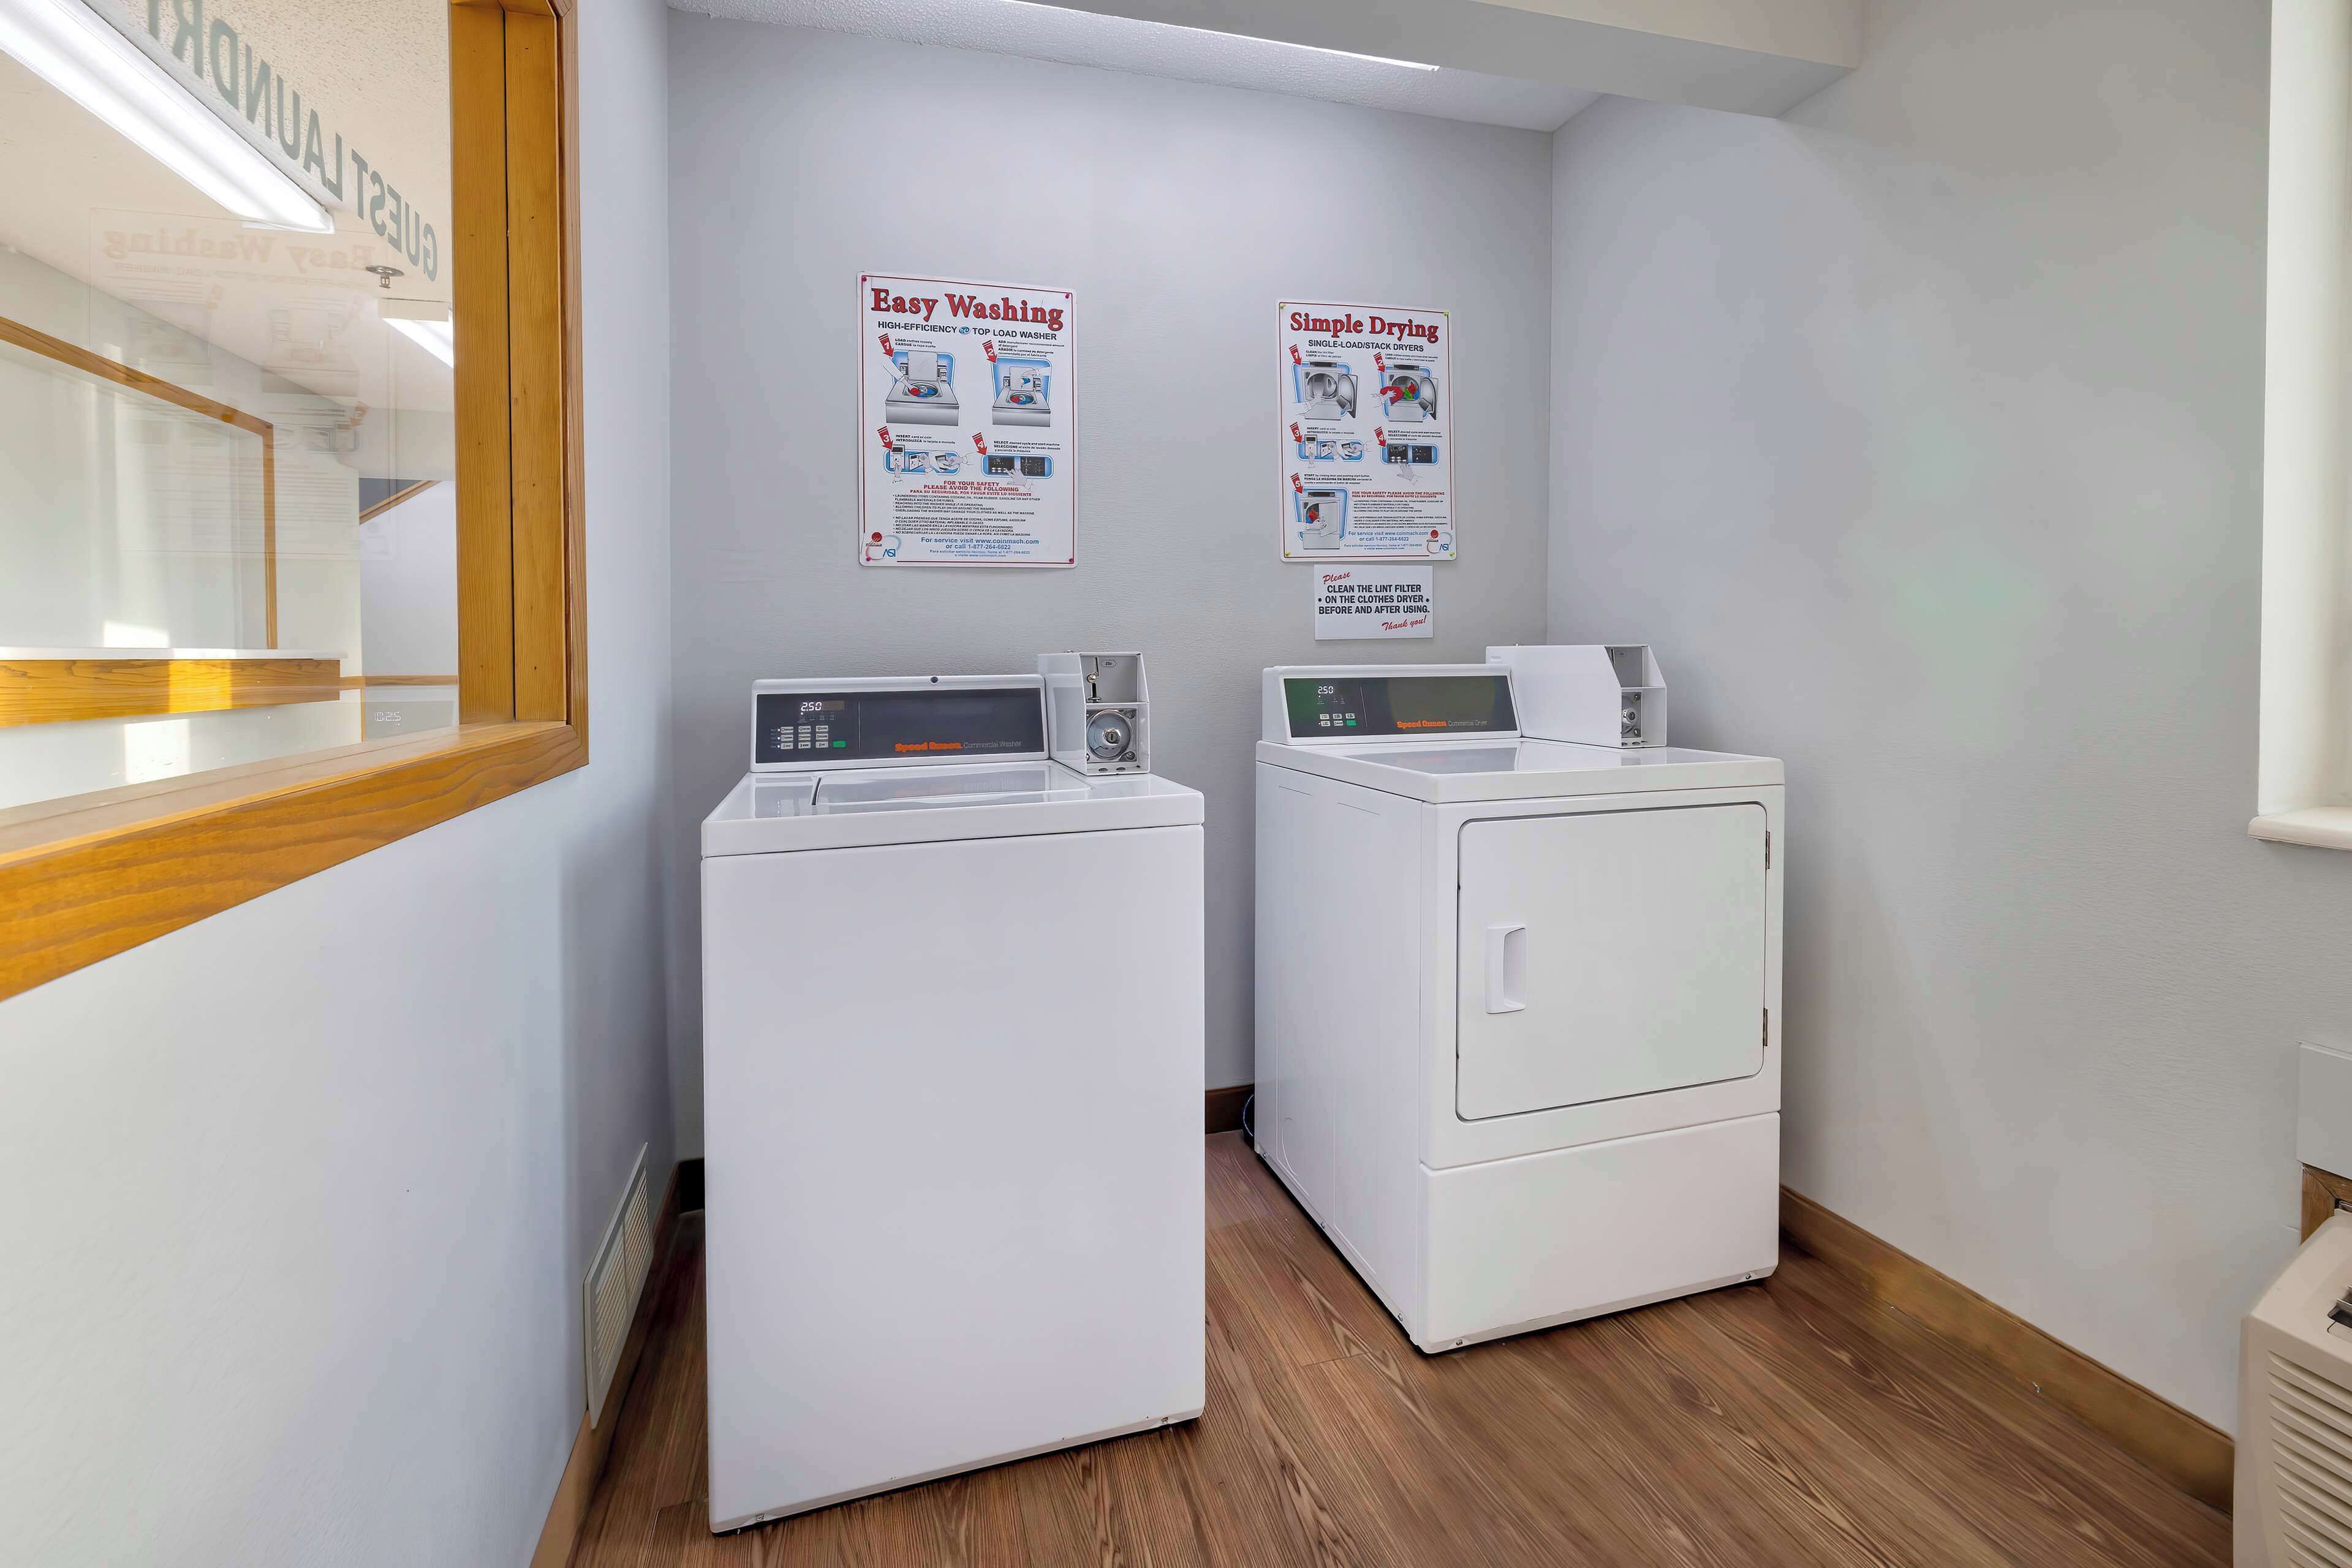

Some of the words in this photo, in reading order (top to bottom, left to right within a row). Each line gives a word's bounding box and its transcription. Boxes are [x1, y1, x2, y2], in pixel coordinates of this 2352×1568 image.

[871, 288, 938, 322] Easy
[945, 293, 1064, 331] Washing
[878, 321, 957, 334] HIGH-EFFICIENCY
[993, 329, 1016, 337] LOAD
[1019, 331, 1057, 340] WASHER
[1290, 312, 1363, 337] Simple
[1369, 316, 1439, 343] Drying
[1309, 339, 1391, 350] SINGLE-LOAD/STACK
[1393, 343, 1424, 352] DRYERS
[1323, 572, 1350, 584] Please
[1382, 620, 1408, 631] Thank
[1410, 615, 1427, 628] you!
[801, 702, 822, 711] 2.50
[1397, 720, 1421, 729] Speed
[894, 742, 928, 753] Speed
